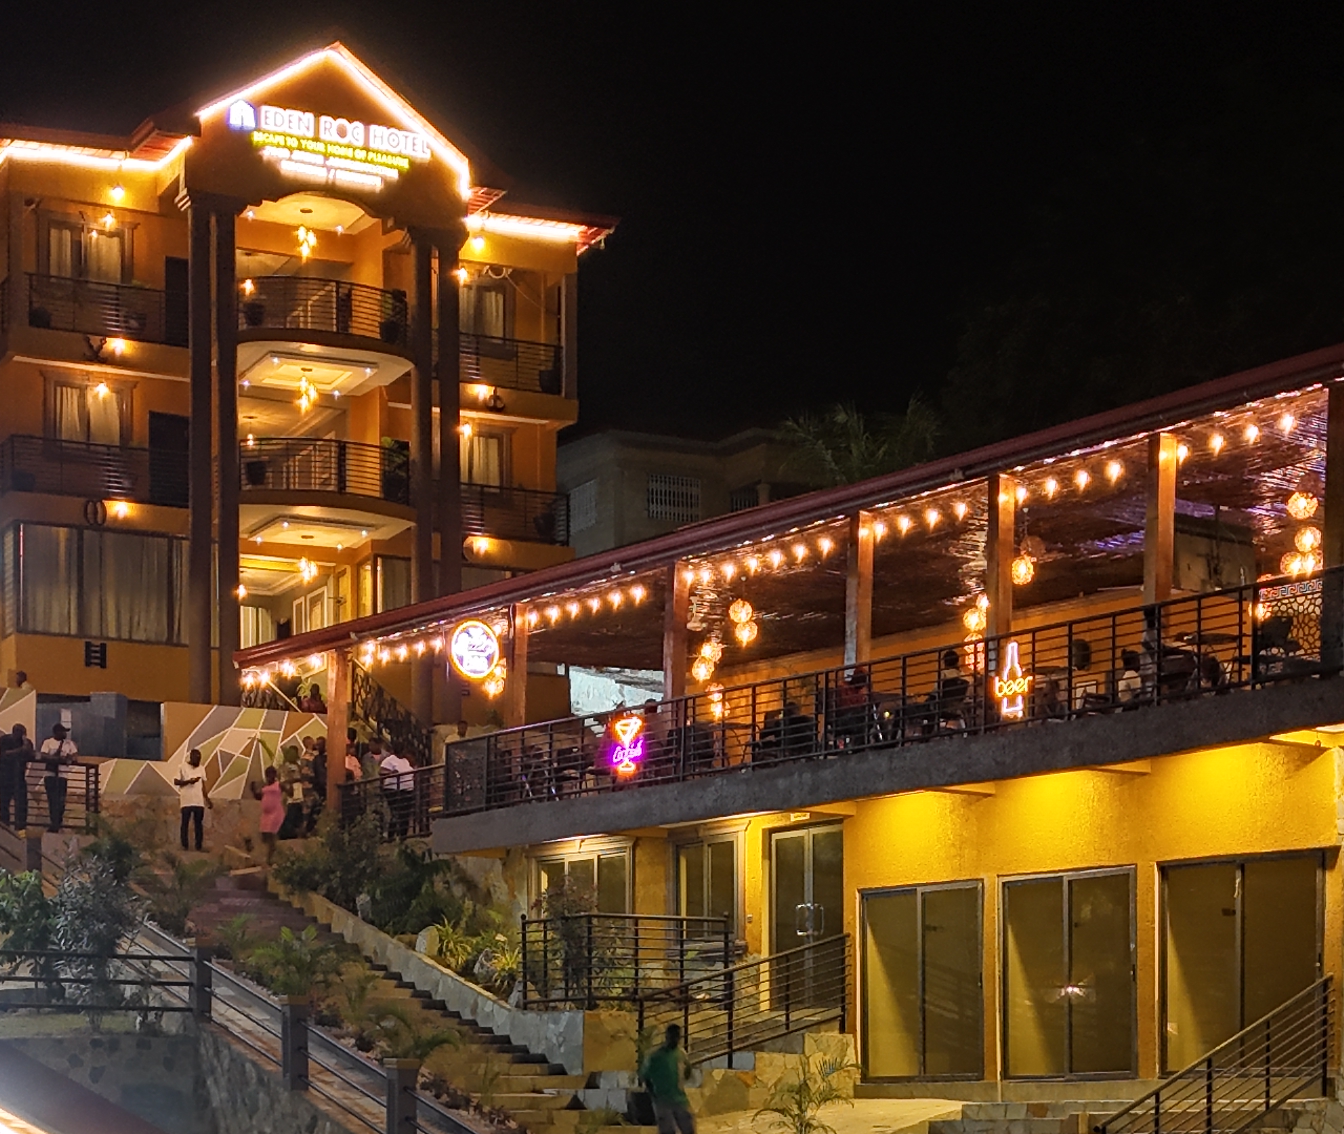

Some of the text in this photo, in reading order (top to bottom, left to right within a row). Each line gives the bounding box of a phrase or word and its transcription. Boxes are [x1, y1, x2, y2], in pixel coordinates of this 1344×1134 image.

[260, 106, 314, 137] EDEN
[370, 124, 431, 158] HOTEL
[286, 136, 298, 148] TO
[300, 138, 326, 152] YOUR
[327, 143, 353, 157] HOME
[354, 148, 367, 160] OF
[994, 676, 1033, 697] beer
